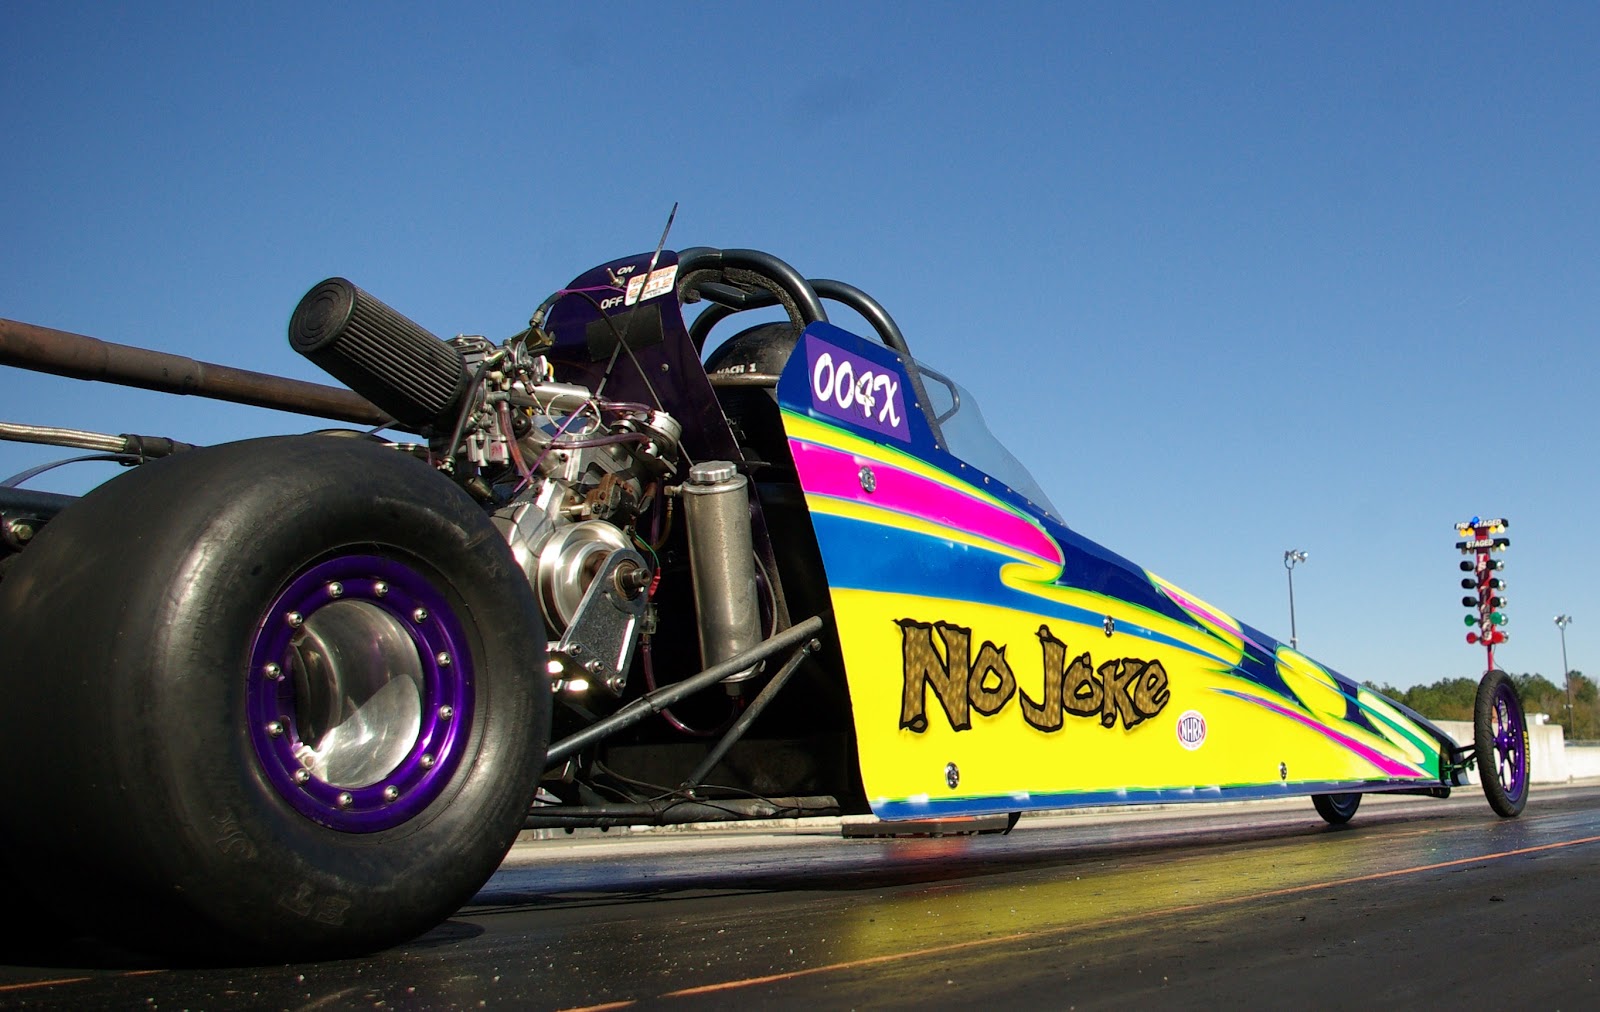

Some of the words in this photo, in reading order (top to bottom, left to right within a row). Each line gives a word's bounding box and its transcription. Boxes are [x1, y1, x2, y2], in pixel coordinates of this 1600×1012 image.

[617, 265, 635, 275] ON
[600, 295, 624, 309] OFF
[813, 352, 901, 428] 004X
[1466, 539, 1494, 549] STAGED
[1181, 718, 1203, 742] NHRA
